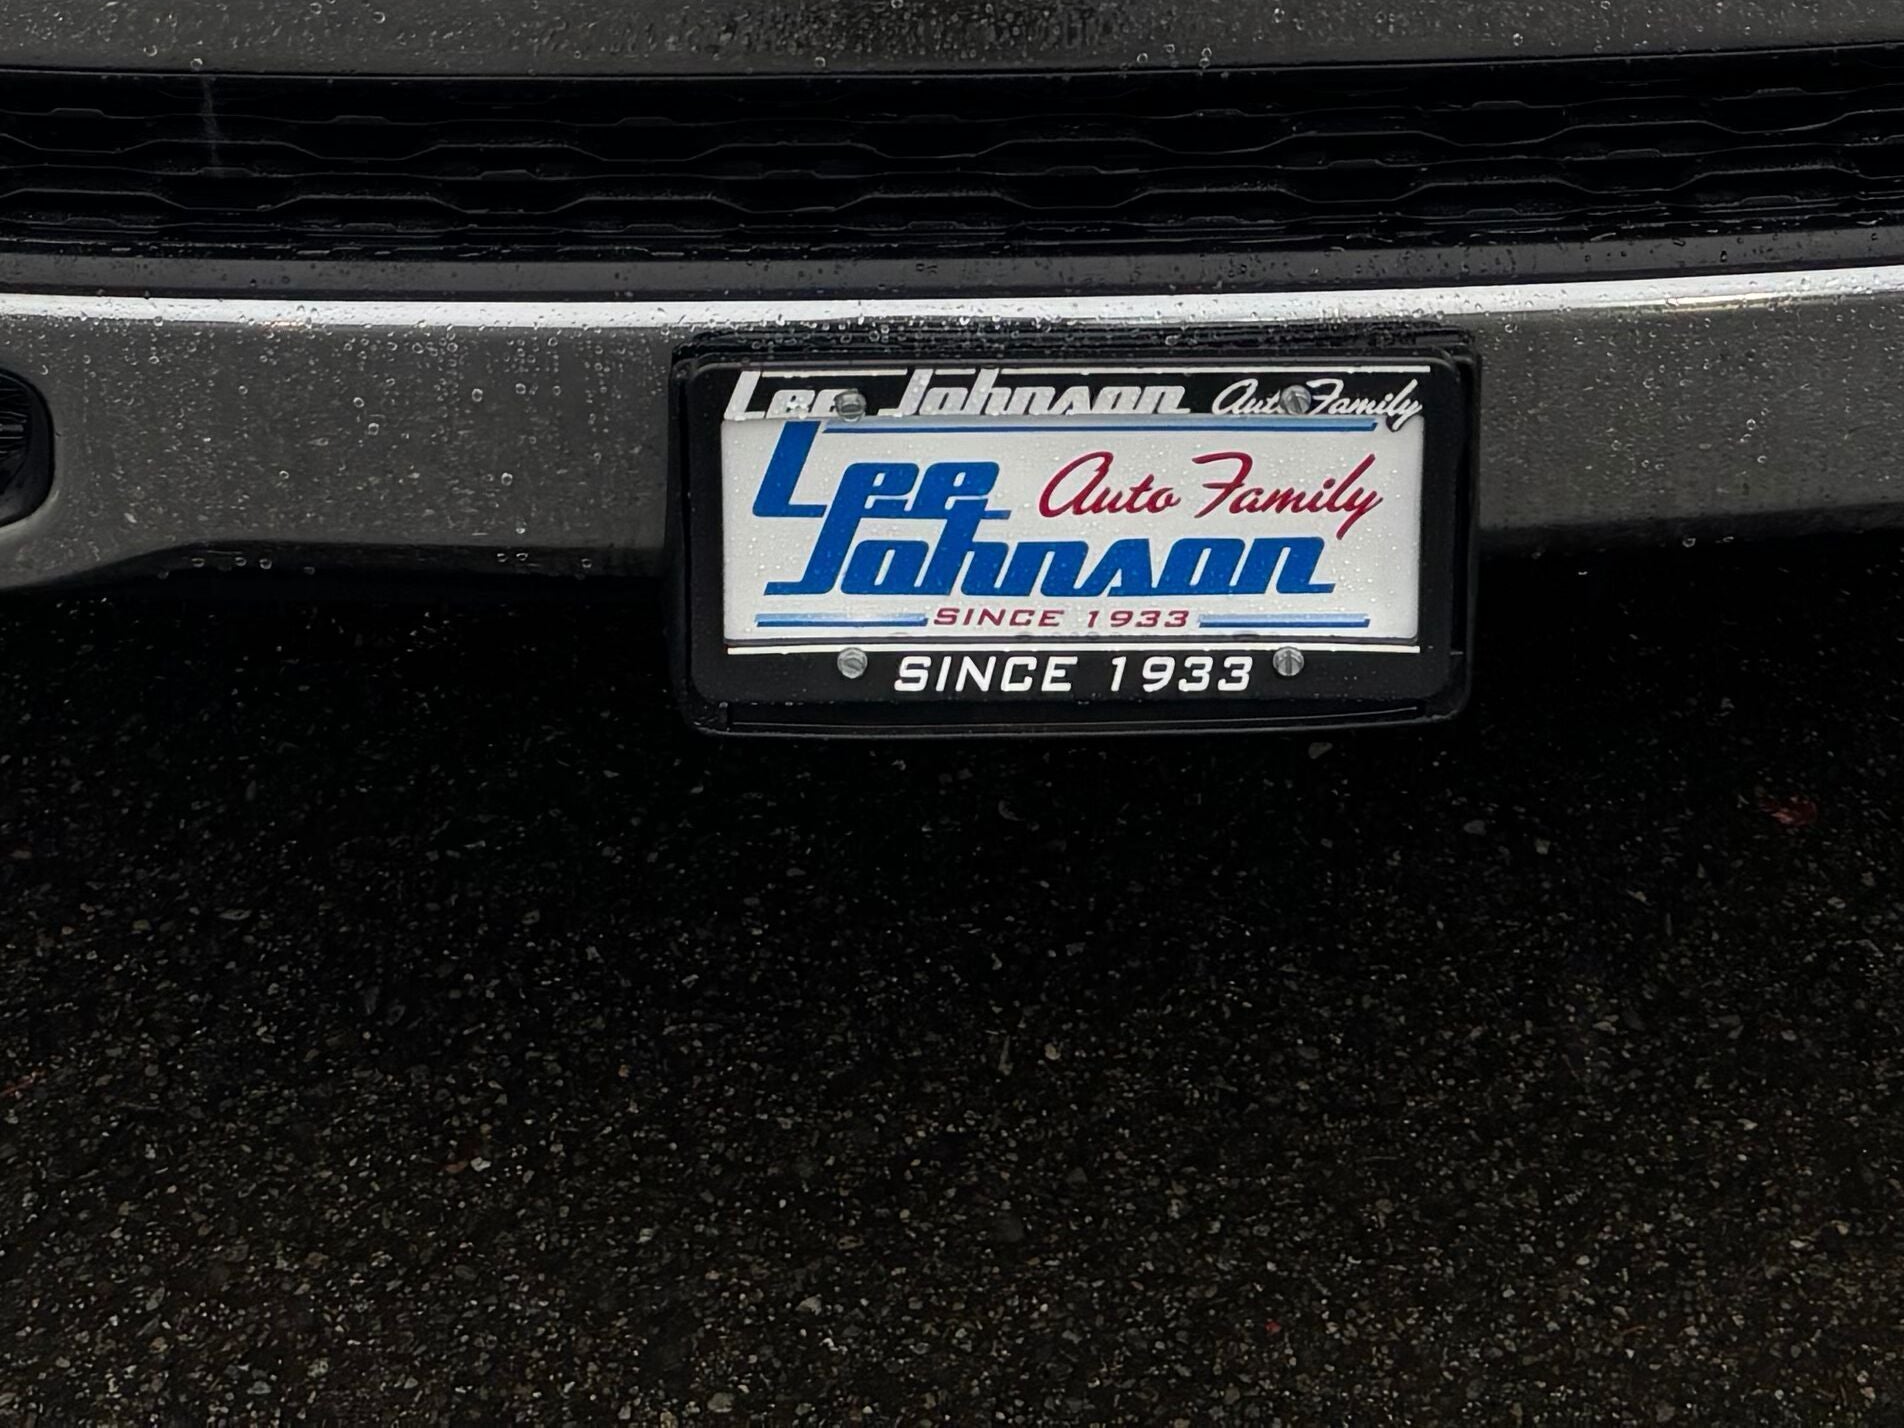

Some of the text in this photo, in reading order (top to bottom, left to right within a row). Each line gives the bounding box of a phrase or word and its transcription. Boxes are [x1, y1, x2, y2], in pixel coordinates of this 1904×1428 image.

[877, 367, 1191, 417] Johnson
[1211, 378, 1286, 416] Aut
[1305, 378, 1423, 432] Family
[752, 420, 1012, 520] Lee
[1038, 451, 1384, 540] Auto Family
[763, 518, 1337, 597] Johnson
[933, 607, 1190, 628] SINCE 1933
[894, 655, 1254, 693] SINCE 1933
